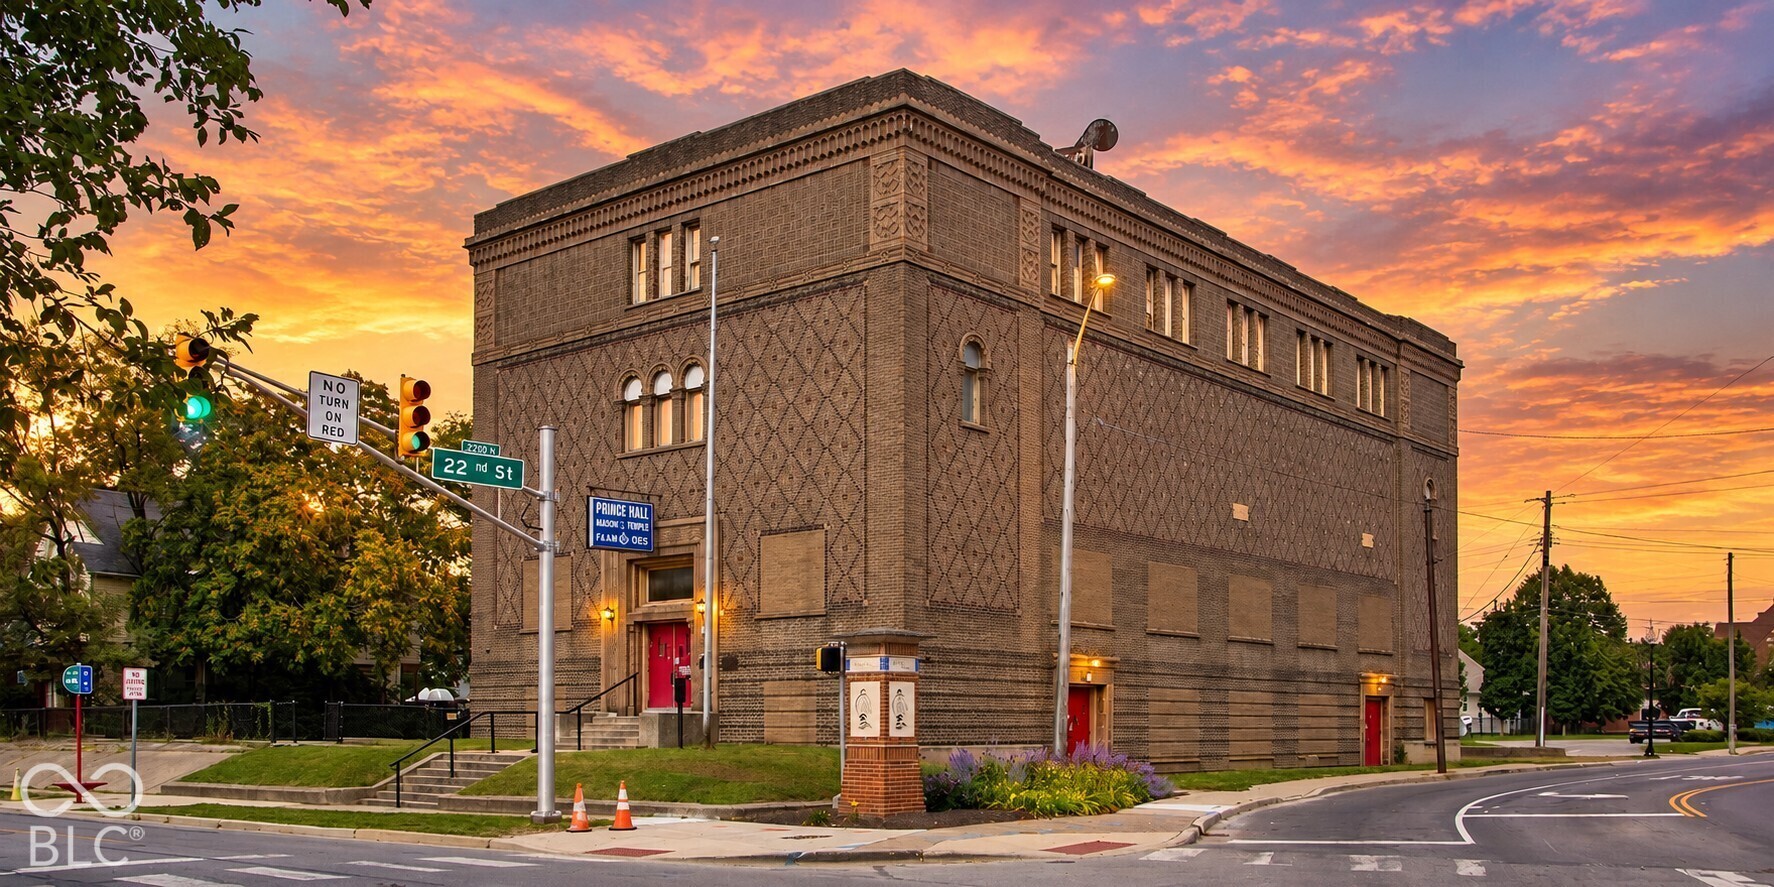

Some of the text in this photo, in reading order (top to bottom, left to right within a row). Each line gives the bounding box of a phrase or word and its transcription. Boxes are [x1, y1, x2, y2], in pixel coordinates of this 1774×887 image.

[323, 379, 346, 394] NO
[319, 394, 349, 410] TURN
[325, 410, 342, 423] ON
[321, 424, 345, 438] RED
[467, 443, 496, 455] 2200 N
[443, 457, 513, 481] 22 nd St
[596, 501, 649, 520] PRINCE HALL
[627, 521, 649, 532] TEMPLE
[631, 535, 649, 546] OES
